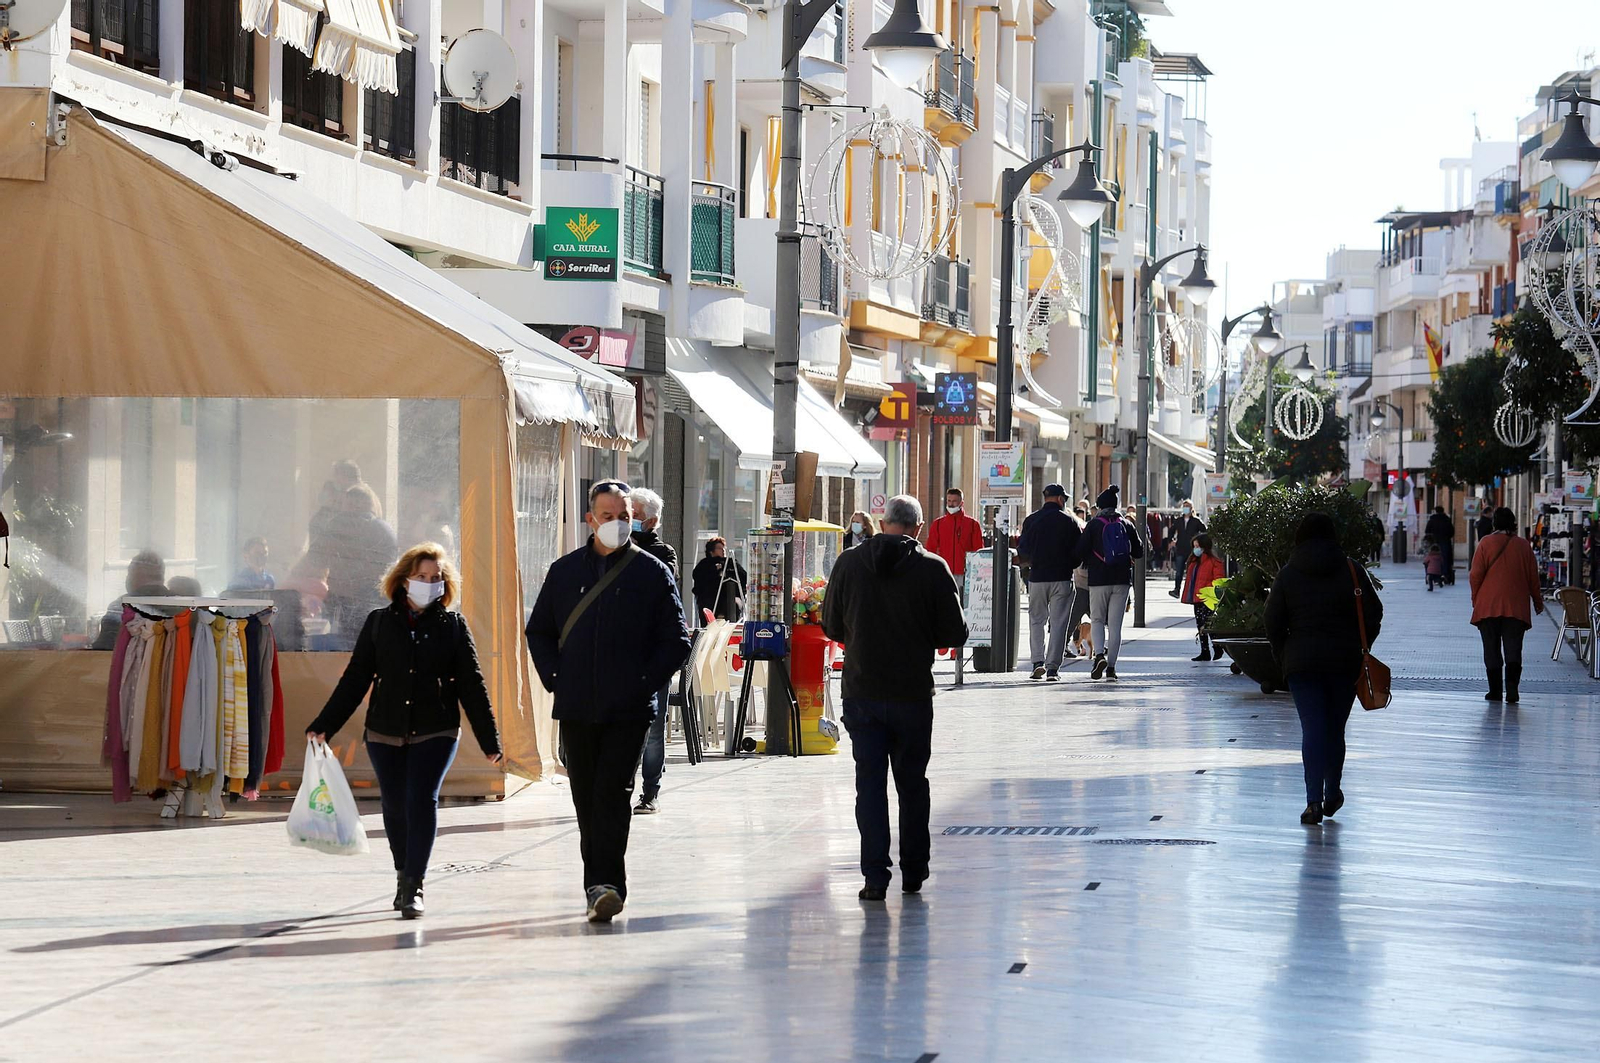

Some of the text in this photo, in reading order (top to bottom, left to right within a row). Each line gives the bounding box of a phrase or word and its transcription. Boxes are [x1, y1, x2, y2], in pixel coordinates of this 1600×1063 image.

[553, 244, 610, 253] CAJA RURAL
[568, 263, 611, 273] ServiRed
